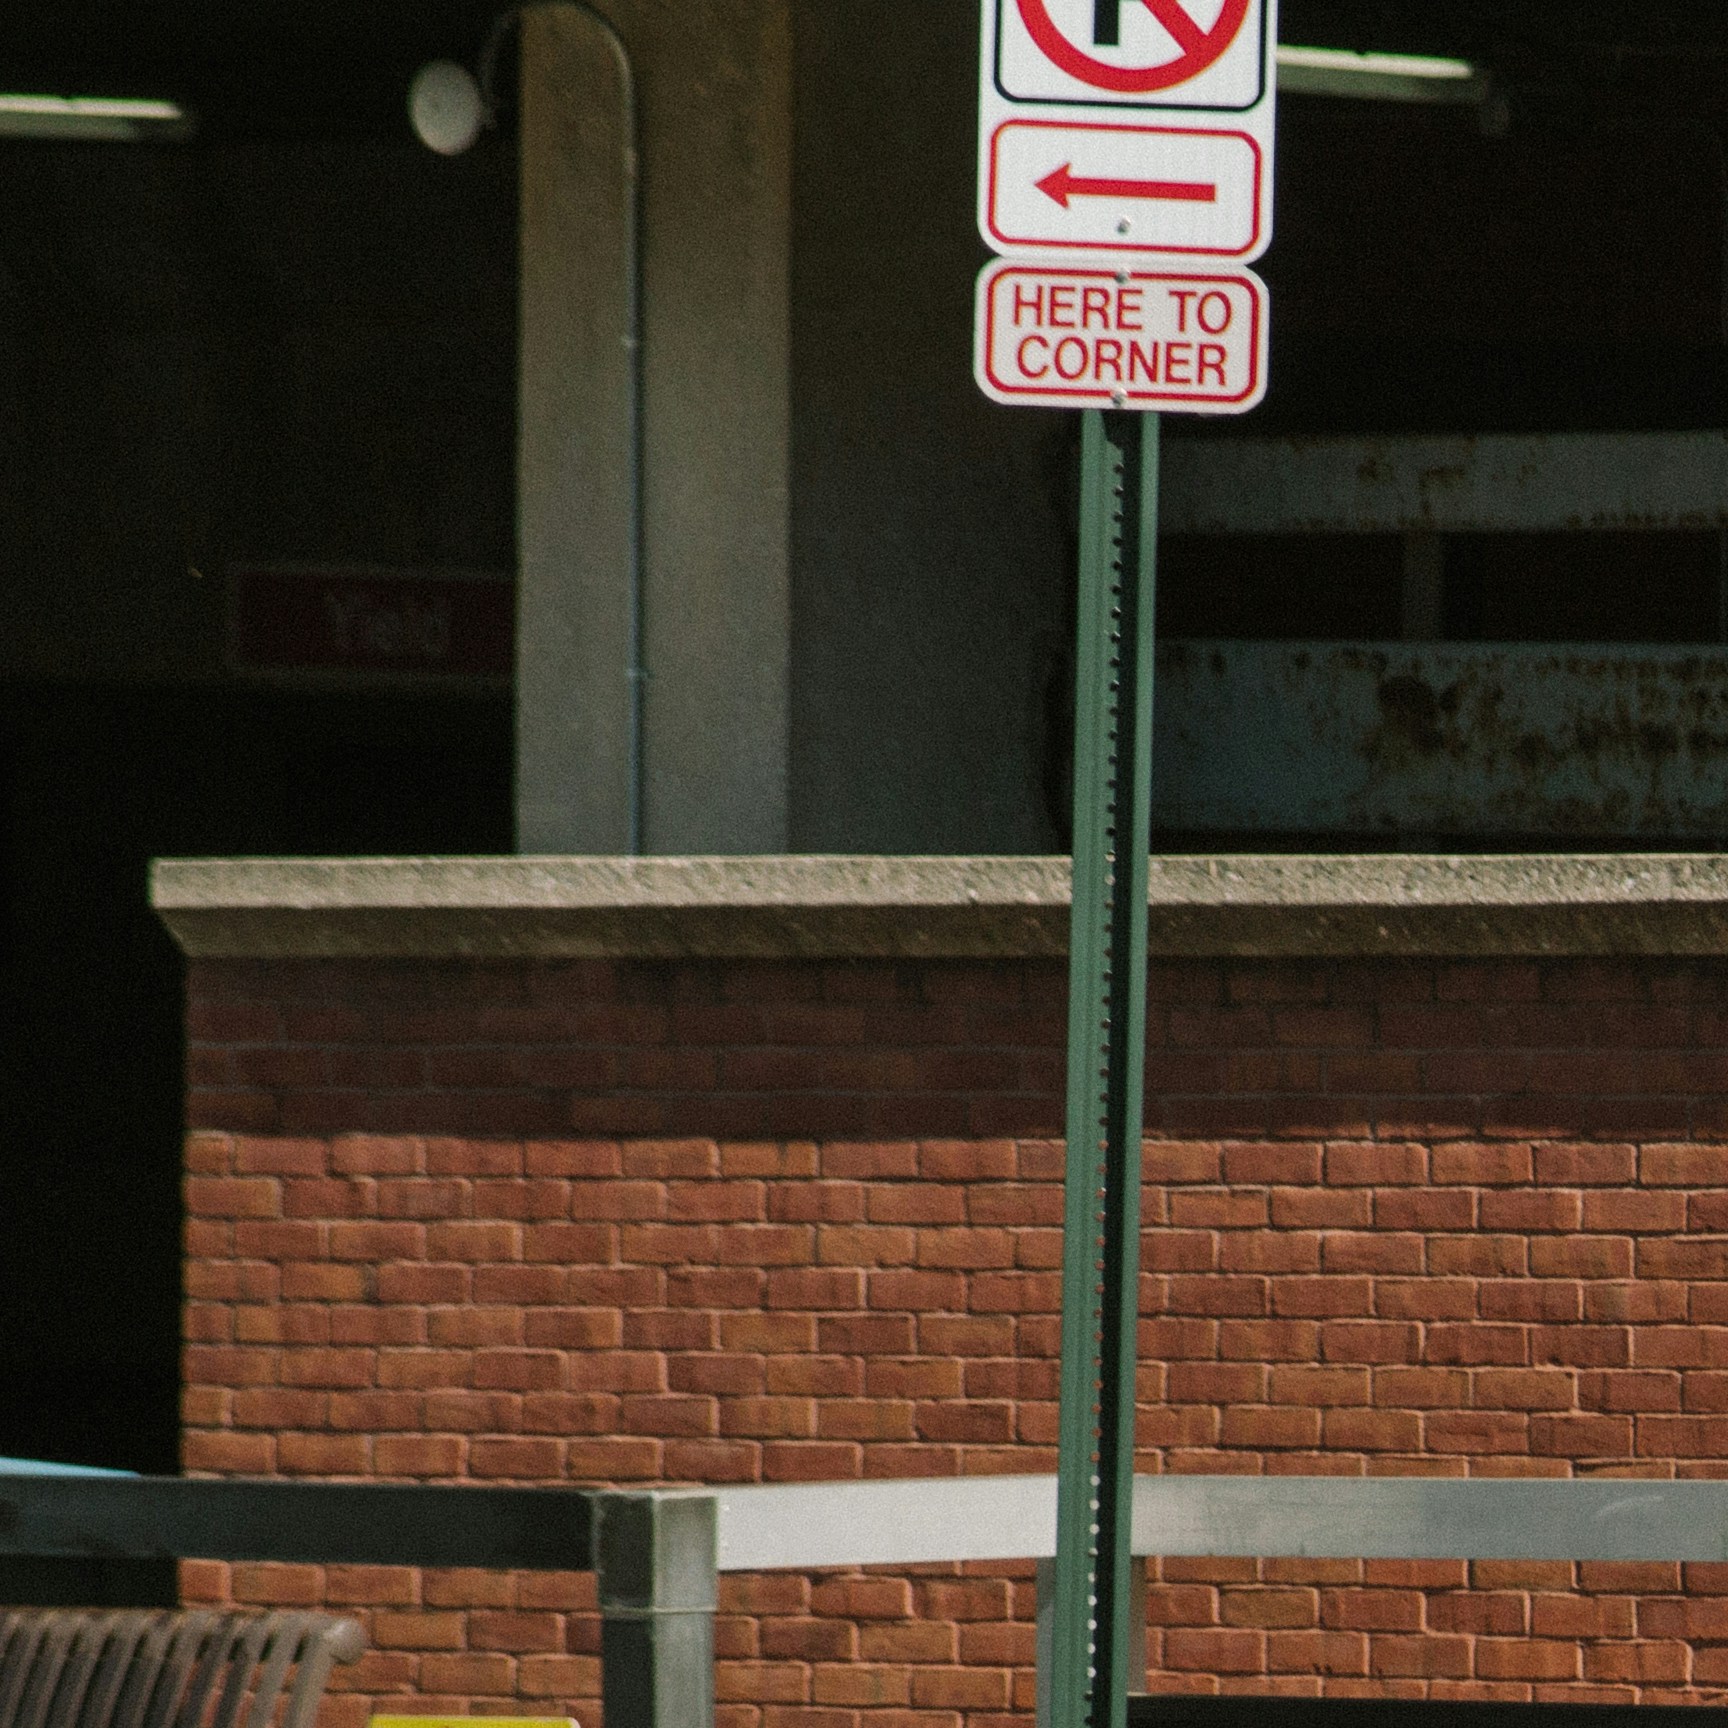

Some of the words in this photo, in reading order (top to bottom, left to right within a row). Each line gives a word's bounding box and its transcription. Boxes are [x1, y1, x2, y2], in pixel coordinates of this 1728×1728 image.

[1013, 284, 1143, 331] HERE
[1169, 290, 1232, 335] TO
[1017, 334, 1227, 386] CORNER
